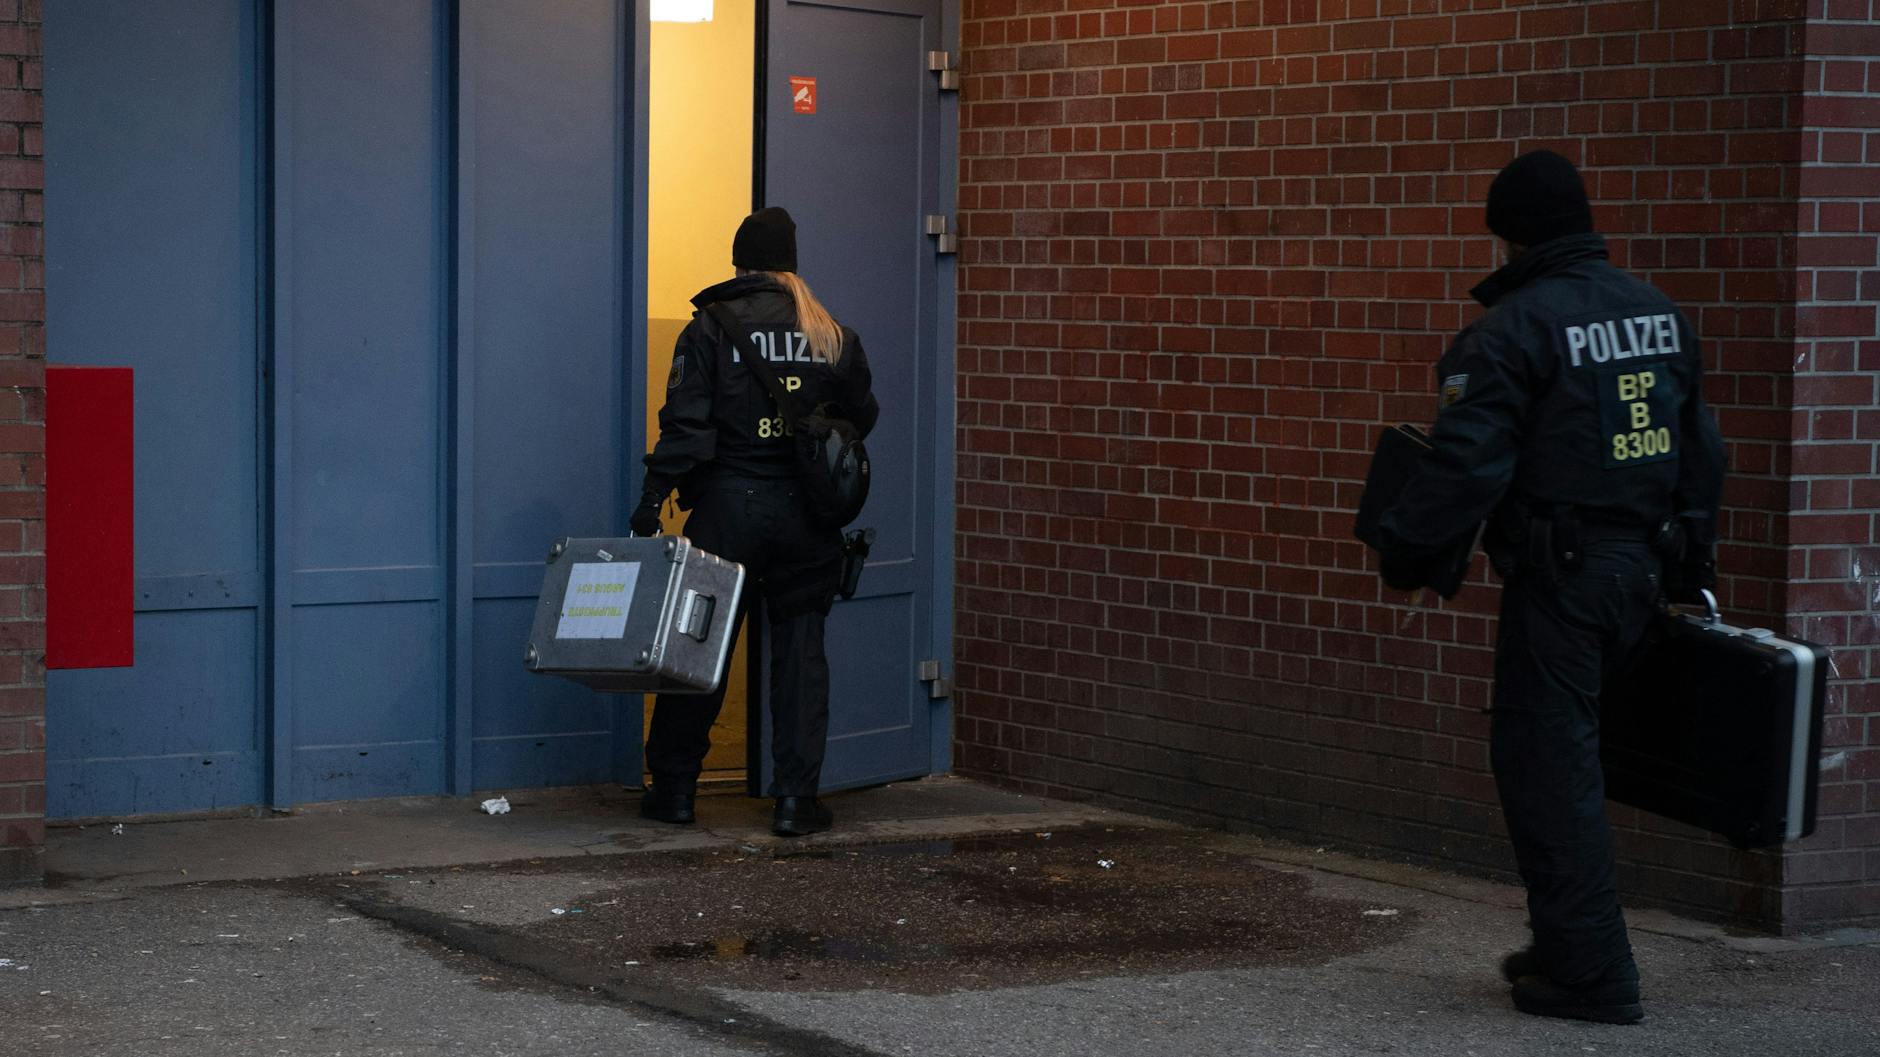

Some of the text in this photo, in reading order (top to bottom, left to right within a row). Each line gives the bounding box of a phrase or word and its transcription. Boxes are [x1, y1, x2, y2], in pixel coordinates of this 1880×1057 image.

[1565, 313, 1681, 366] POLIZEI
[1617, 371, 1656, 401] BP
[1629, 402, 1651, 429] B
[1612, 427, 1671, 461] 8300
